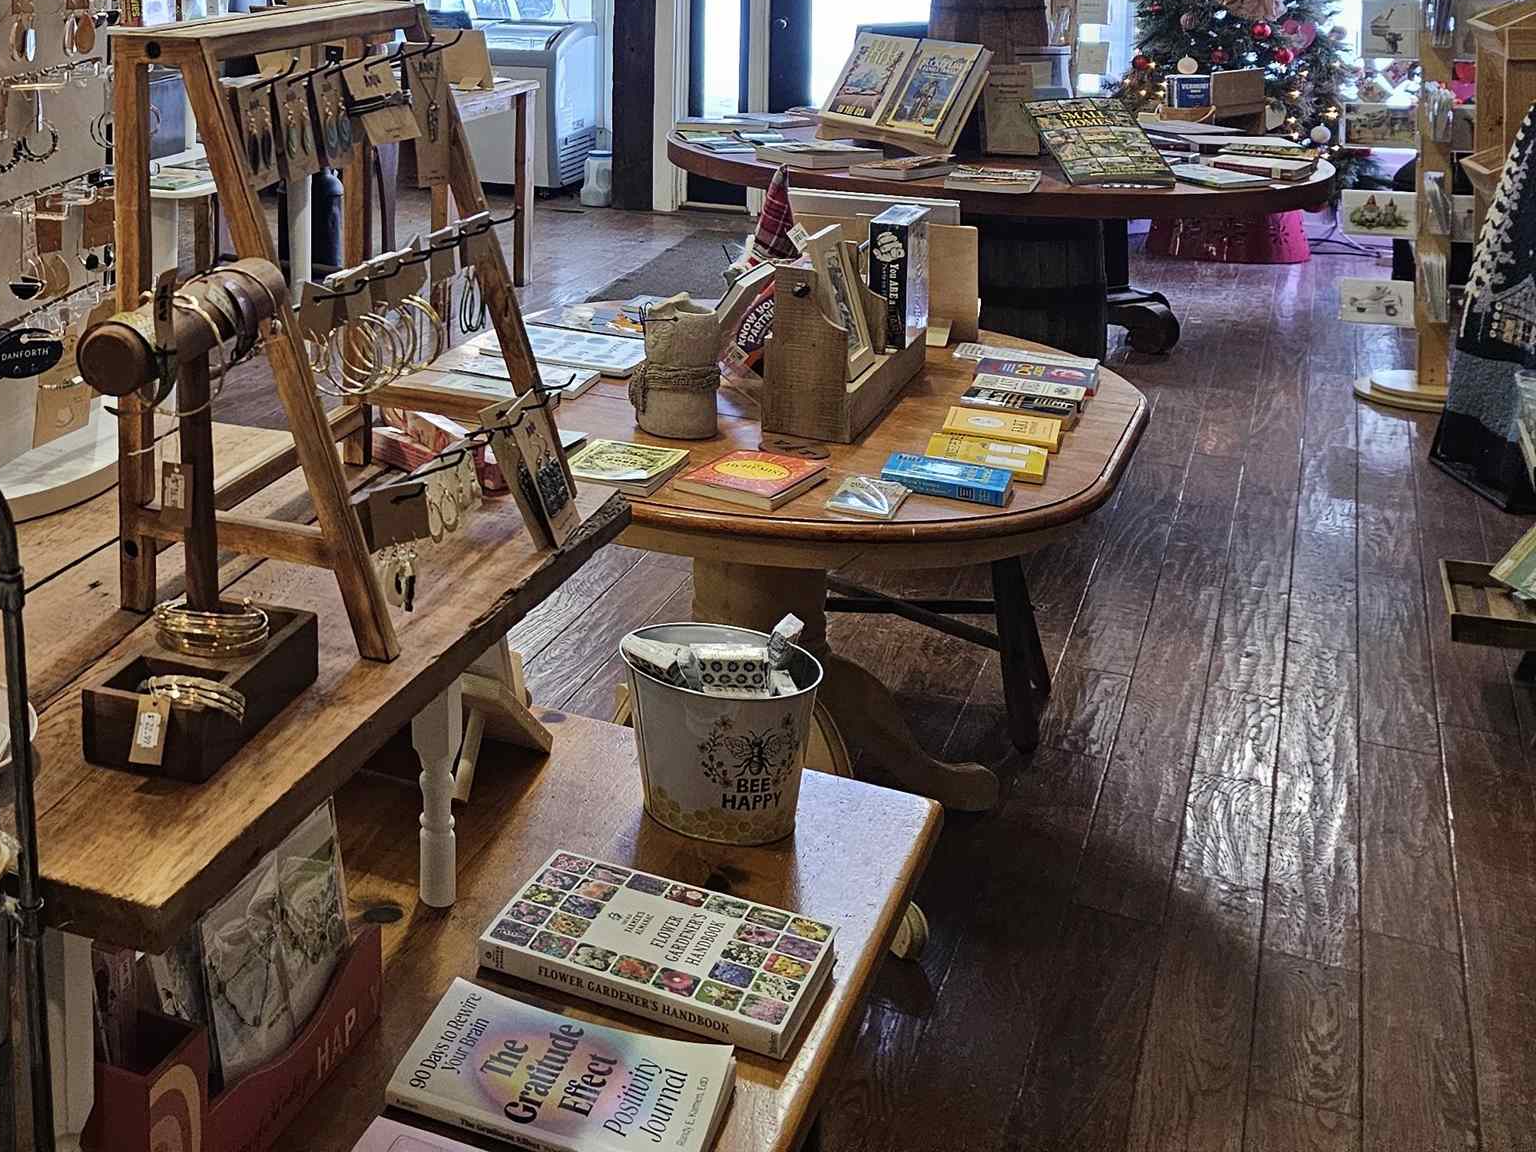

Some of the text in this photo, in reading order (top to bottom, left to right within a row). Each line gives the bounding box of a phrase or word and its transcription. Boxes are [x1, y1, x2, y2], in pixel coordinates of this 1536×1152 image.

[1060, 109, 1105, 120] SMALL
[1063, 117, 1114, 128] HOMES
[889, 262, 900, 279] You
[737, 312, 758, 346] KNOW
[1, 347, 49, 361] DANFORTH
[721, 791, 782, 811] HAPPY
[736, 778, 770, 793] BEE
[650, 915, 685, 948] FLOWER
[664, 912, 708, 962] GARDENER'S
[685, 920, 726, 966] HANDBOOK
[536, 964, 730, 1035] FLOWER GARDENER'S HANDBOOK
[409, 992, 483, 1089] 90 Days to Rewire
[440, 1017, 490, 1075] Your Brain
[479, 1038, 529, 1078] The
[503, 1022, 585, 1124] Gratitude
[557, 1053, 618, 1118] Effect
[602, 1057, 663, 1138] Positivity
[639, 1067, 689, 1144] Journal
